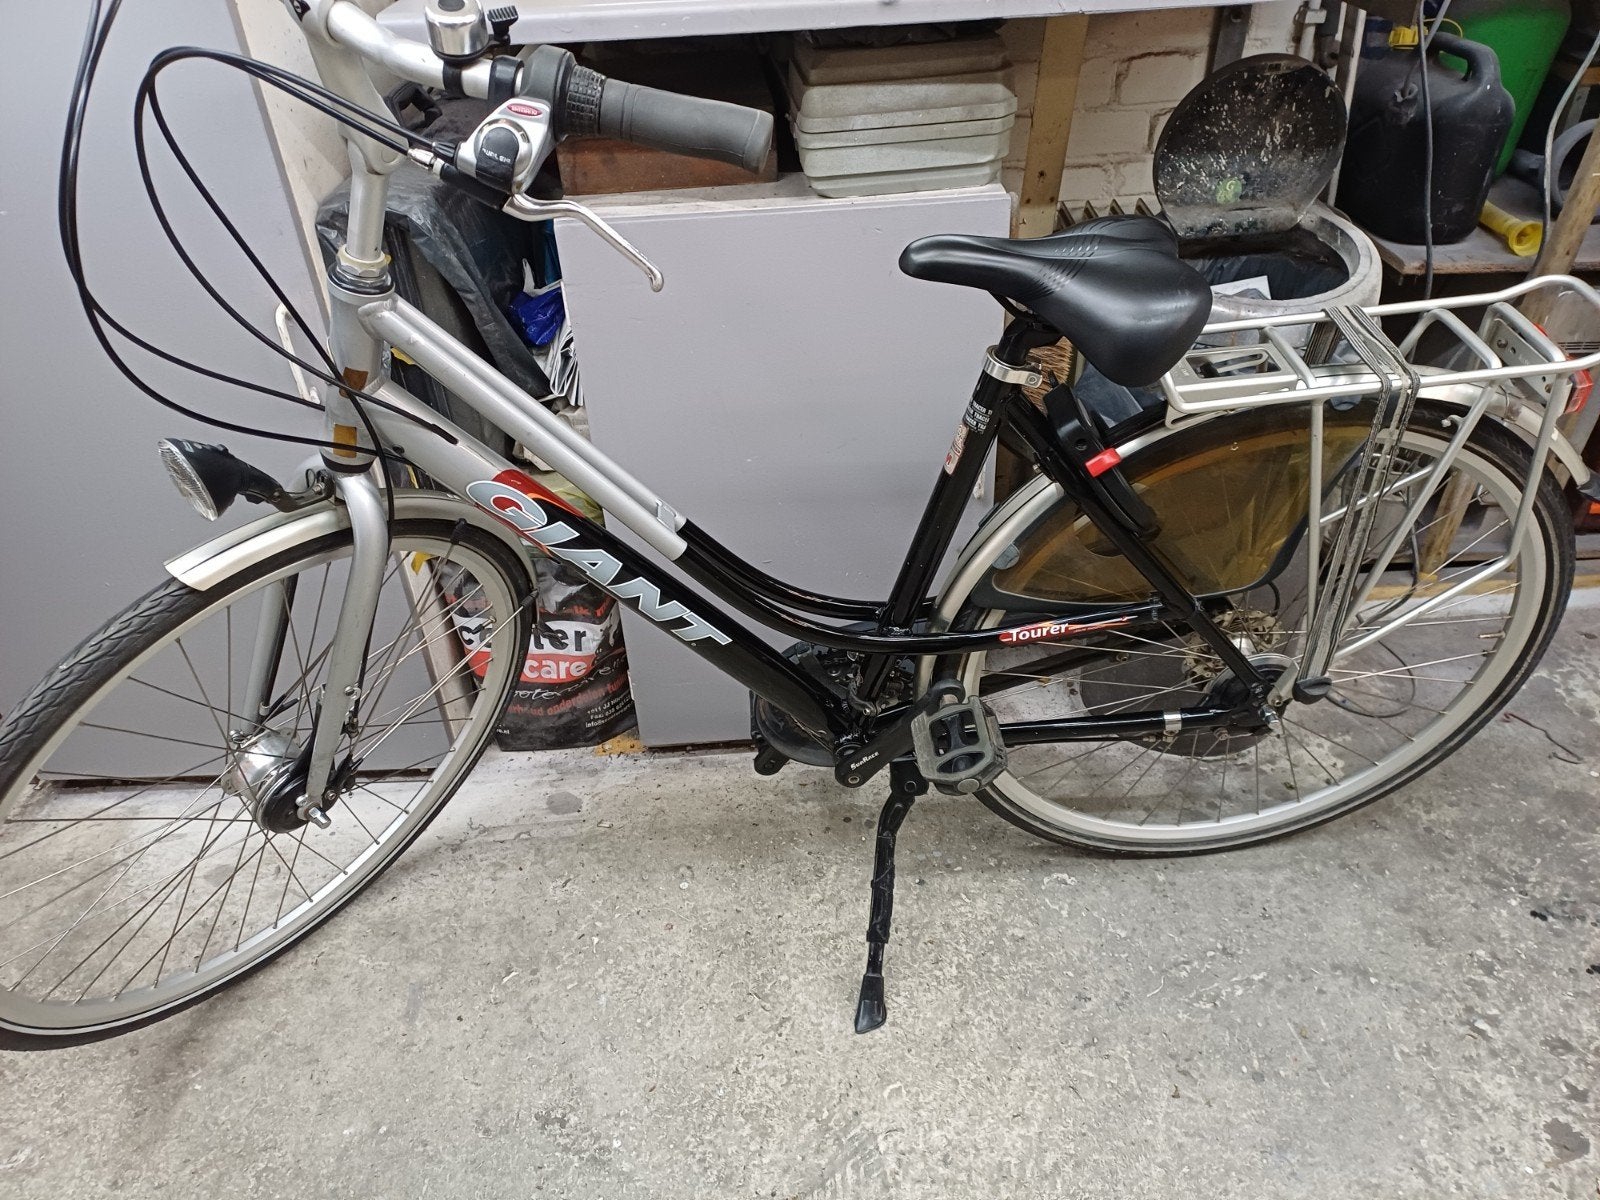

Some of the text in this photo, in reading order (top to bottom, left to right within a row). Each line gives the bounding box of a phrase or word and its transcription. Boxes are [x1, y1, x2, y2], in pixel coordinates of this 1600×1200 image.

[466, 480, 733, 645] GIANT
[1009, 623, 1069, 642] Tourer
[523, 659, 588, 679] care
